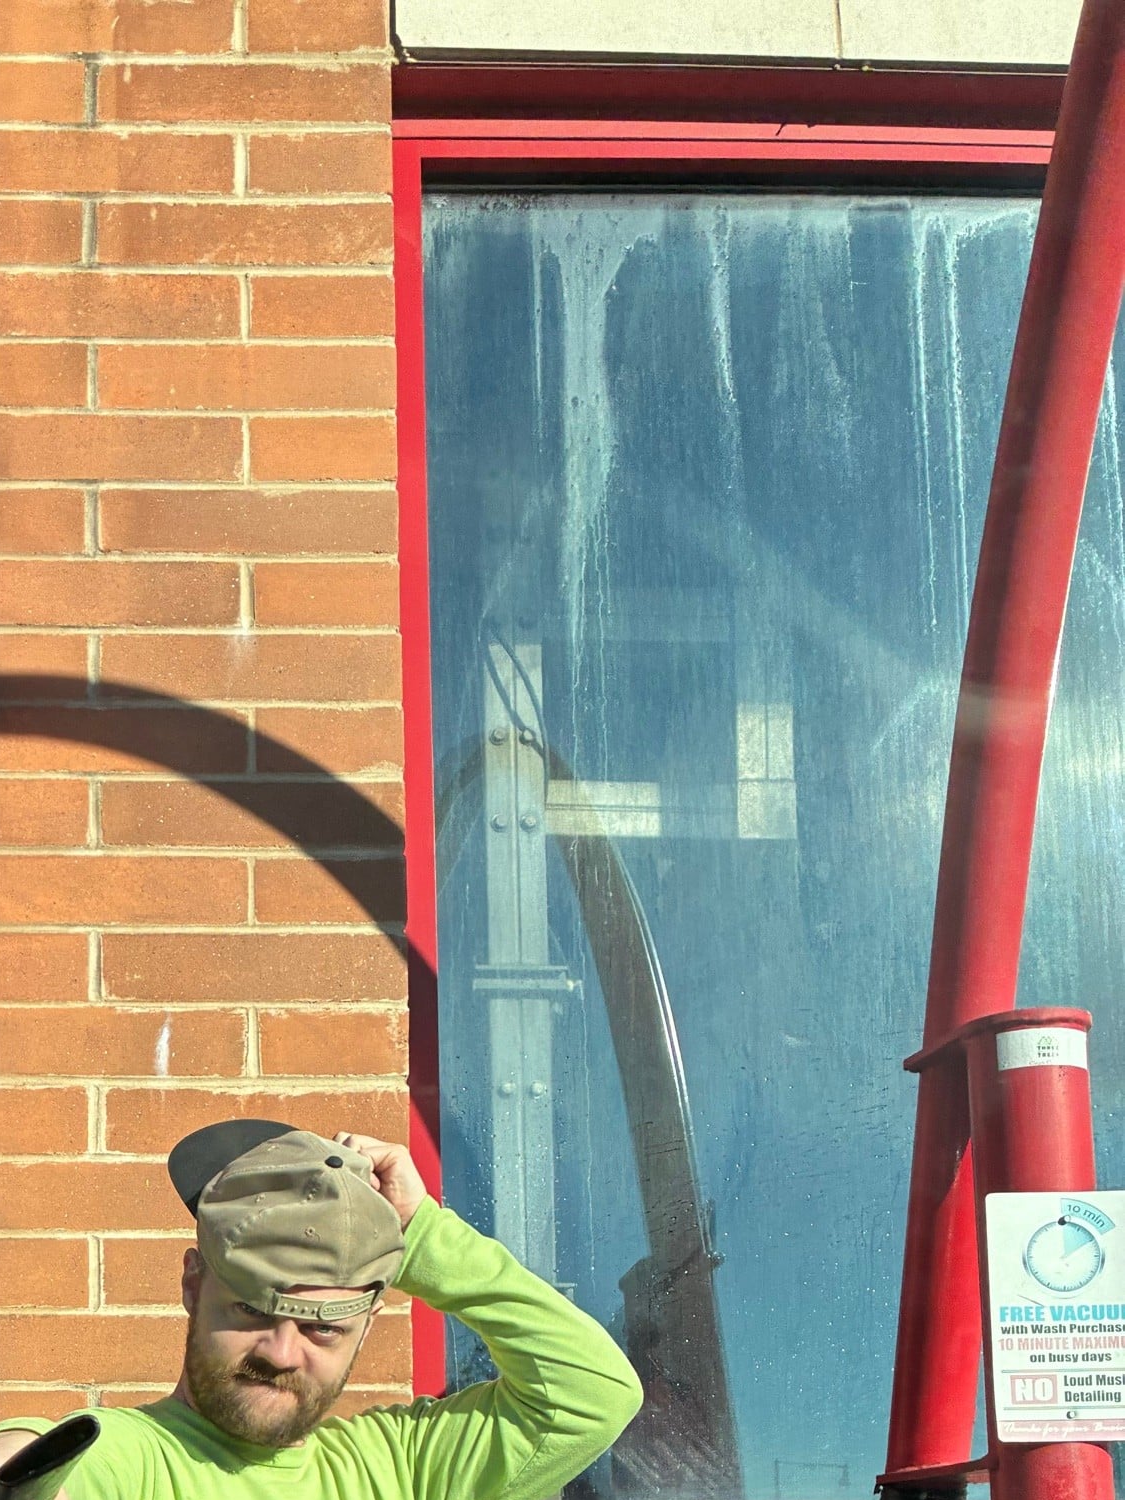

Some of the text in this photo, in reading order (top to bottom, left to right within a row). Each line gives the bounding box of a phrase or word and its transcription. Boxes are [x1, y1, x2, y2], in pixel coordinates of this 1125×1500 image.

[1067, 1204, 1105, 1228] 10 min
[999, 1304, 1125, 1322] FREE VACUU
[1001, 1325, 1028, 1334] with
[1031, 1324, 1067, 1334] Wash
[998, 1338, 1014, 1351] 10
[1018, 1337, 1069, 1350] MINUTE
[1030, 1352, 1112, 1363] on busy days
[1063, 1375, 1093, 1387] Loud
[1014, 1377, 1054, 1402] NO
[1064, 1390, 1122, 1403] Detailing
